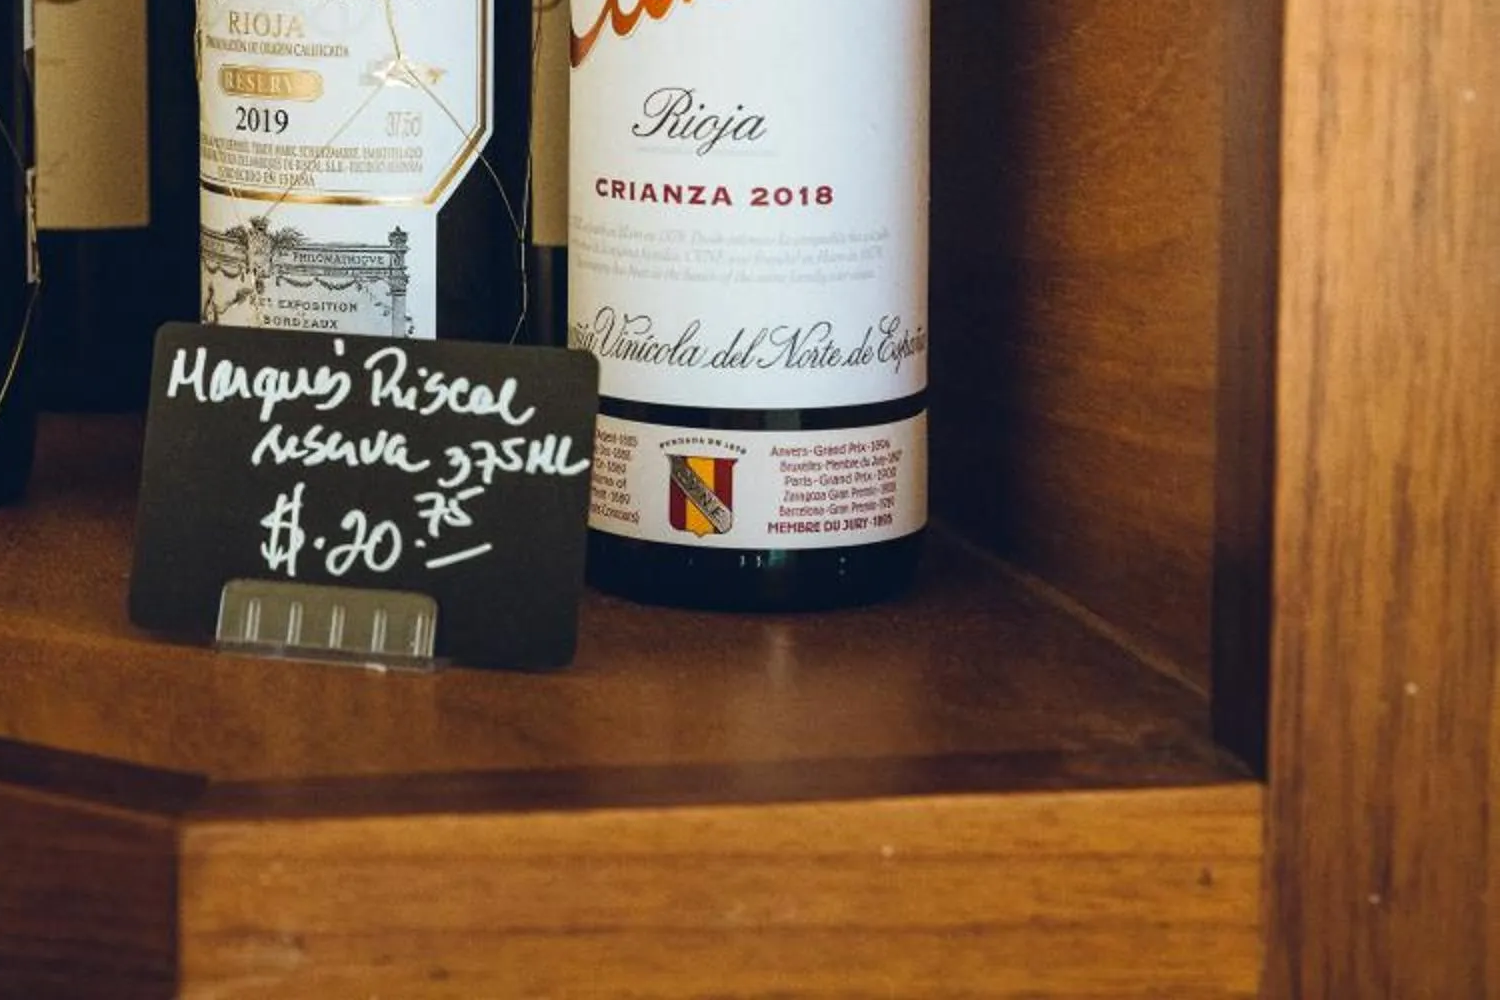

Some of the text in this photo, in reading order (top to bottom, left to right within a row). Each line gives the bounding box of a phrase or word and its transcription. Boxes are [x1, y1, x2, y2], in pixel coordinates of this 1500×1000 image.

[228, 10, 306, 38] RIOJA
[235, 105, 290, 135] 2019
[632, 86, 768, 157] Rioja
[595, 177, 835, 207] CRIANZA 2018
[278, 300, 358, 313] EXPOSITION
[263, 315, 340, 330] BORDEAUX
[703, 328, 768, 369] del
[757, 321, 843, 369] Norte
[842, 325, 875, 367] de
[364, 346, 536, 426] Riscal
[767, 521, 821, 534] MEMBRE
[823, 519, 841, 532] DU
